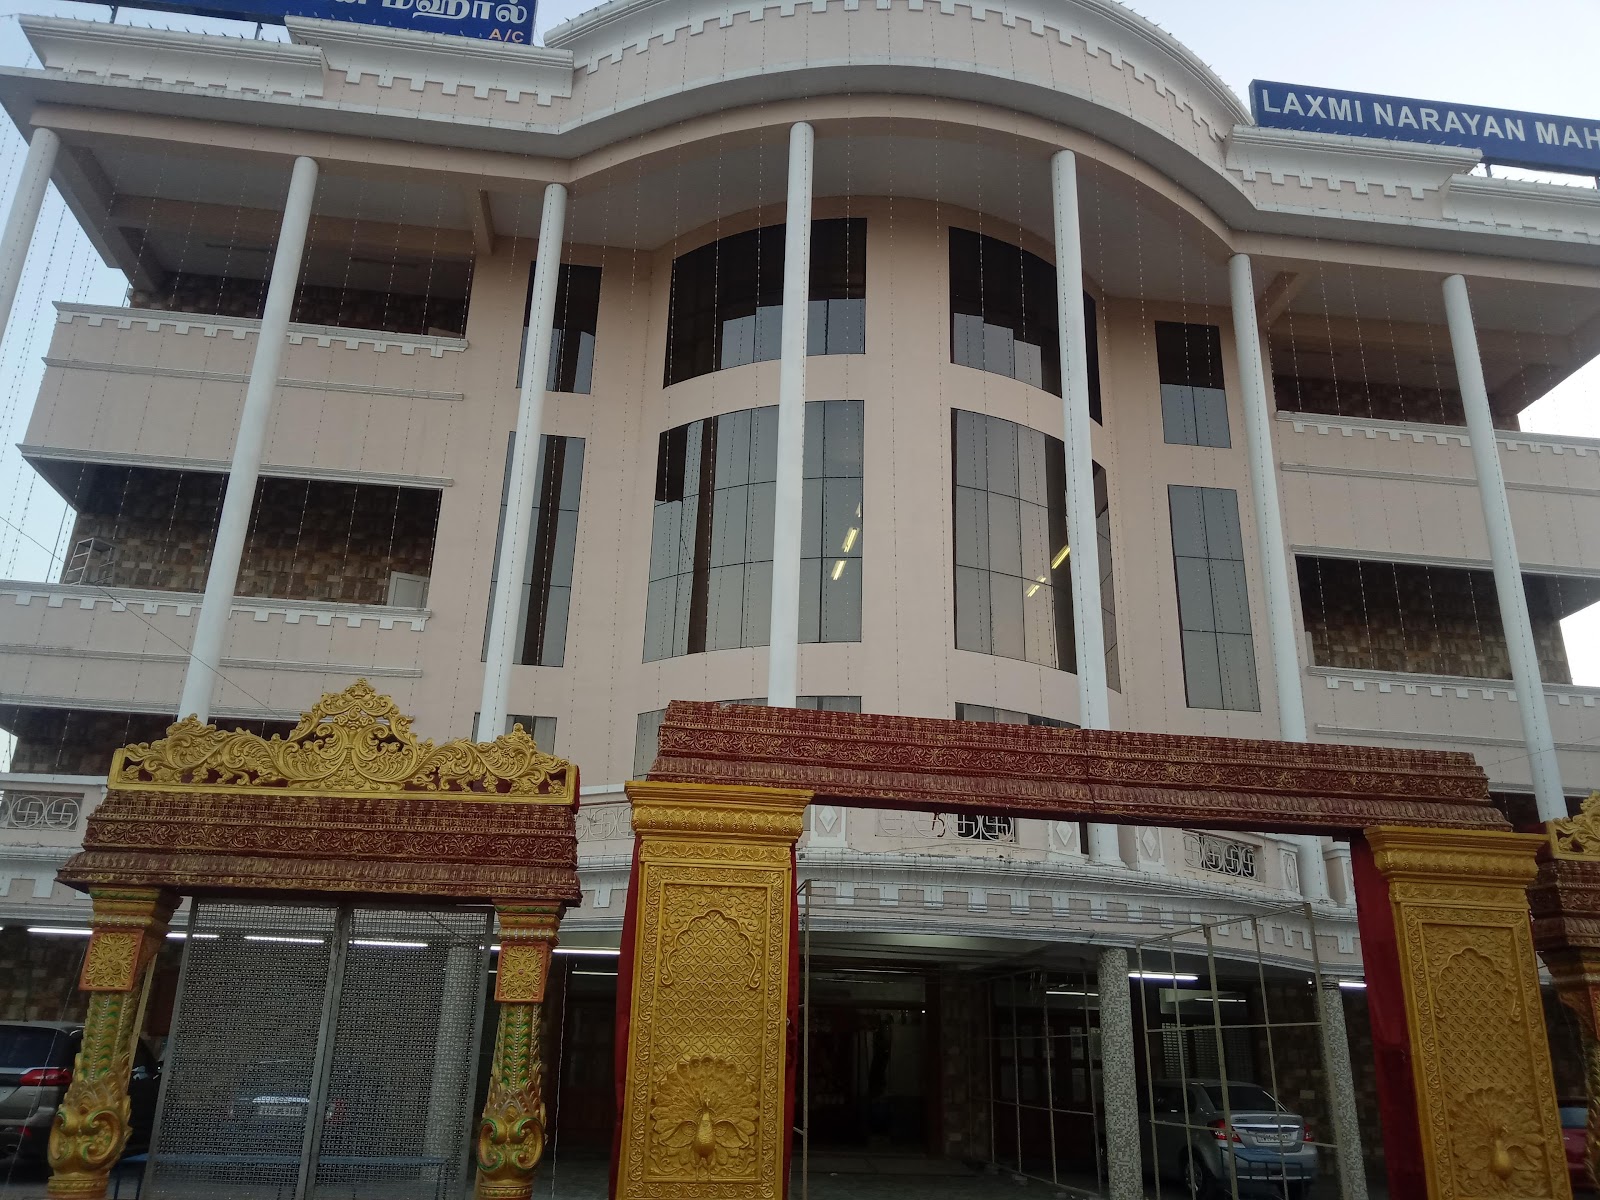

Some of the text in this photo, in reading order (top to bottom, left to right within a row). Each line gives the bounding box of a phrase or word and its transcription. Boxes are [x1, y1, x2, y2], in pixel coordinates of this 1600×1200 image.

[489, 28, 524, 43] A/C
[1262, 89, 1600, 150] LAXMI NARAYAN MAH
